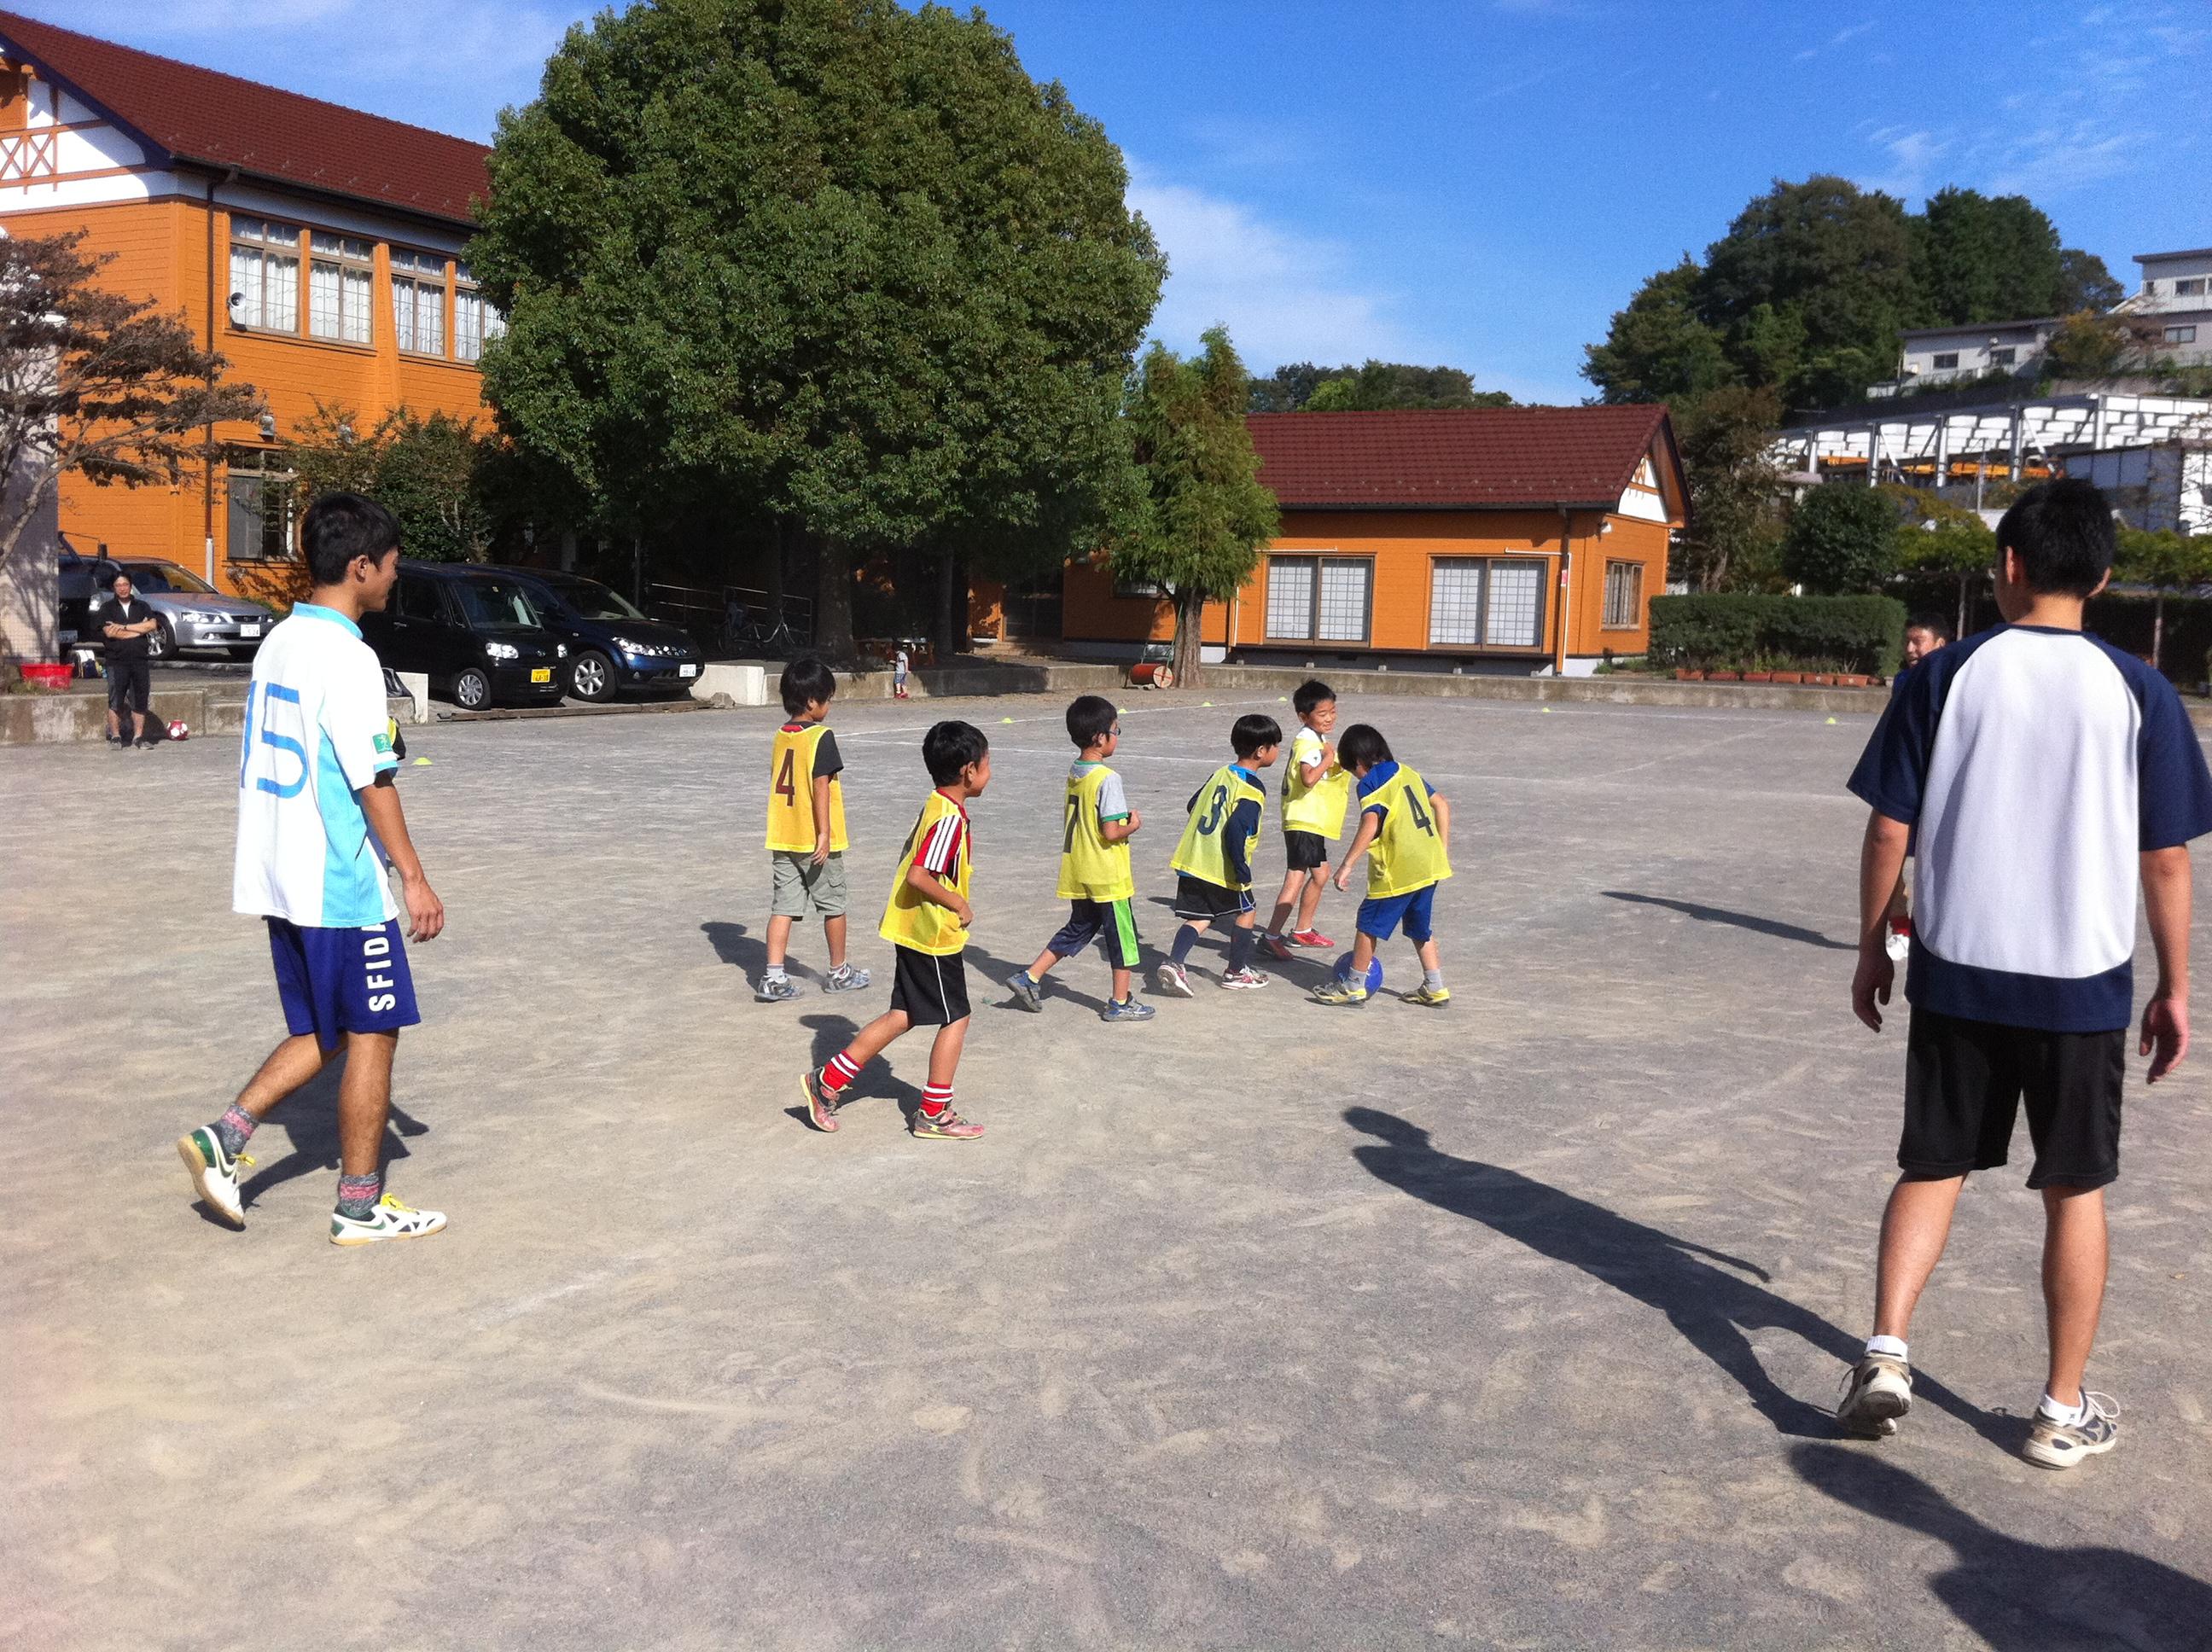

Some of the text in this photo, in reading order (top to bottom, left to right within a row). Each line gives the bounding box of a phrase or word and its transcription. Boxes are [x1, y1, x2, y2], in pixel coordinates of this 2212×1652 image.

[241, 680, 309, 799] 15
[776, 748, 795, 806] 4
[1063, 794, 1080, 853] 7
[1403, 784, 1434, 837] 4
